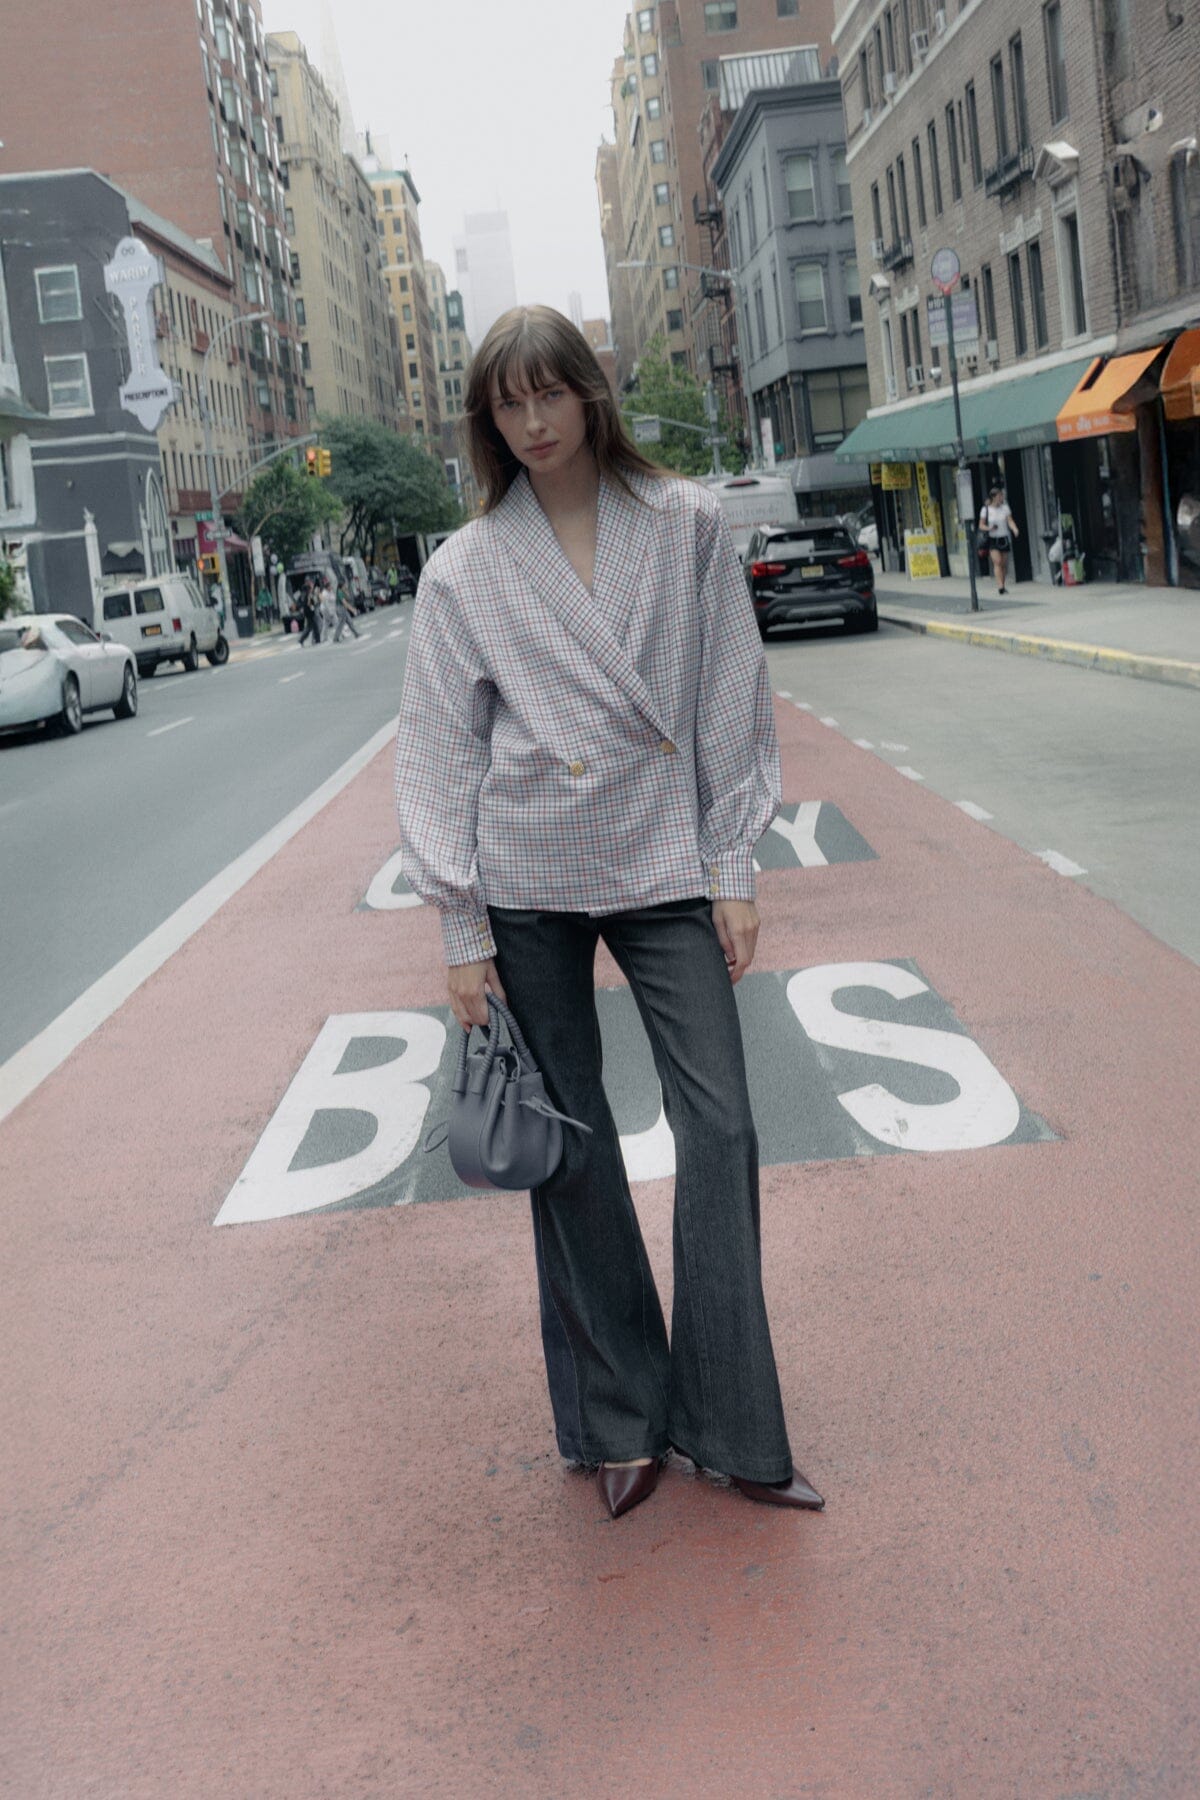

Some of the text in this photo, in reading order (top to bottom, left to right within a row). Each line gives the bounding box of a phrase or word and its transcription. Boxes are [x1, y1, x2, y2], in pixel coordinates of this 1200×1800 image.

[111, 265, 150, 283] WARBY
[130, 297, 145, 376] PARKER
[124, 388, 168, 400] PRESCRIPTIONS
